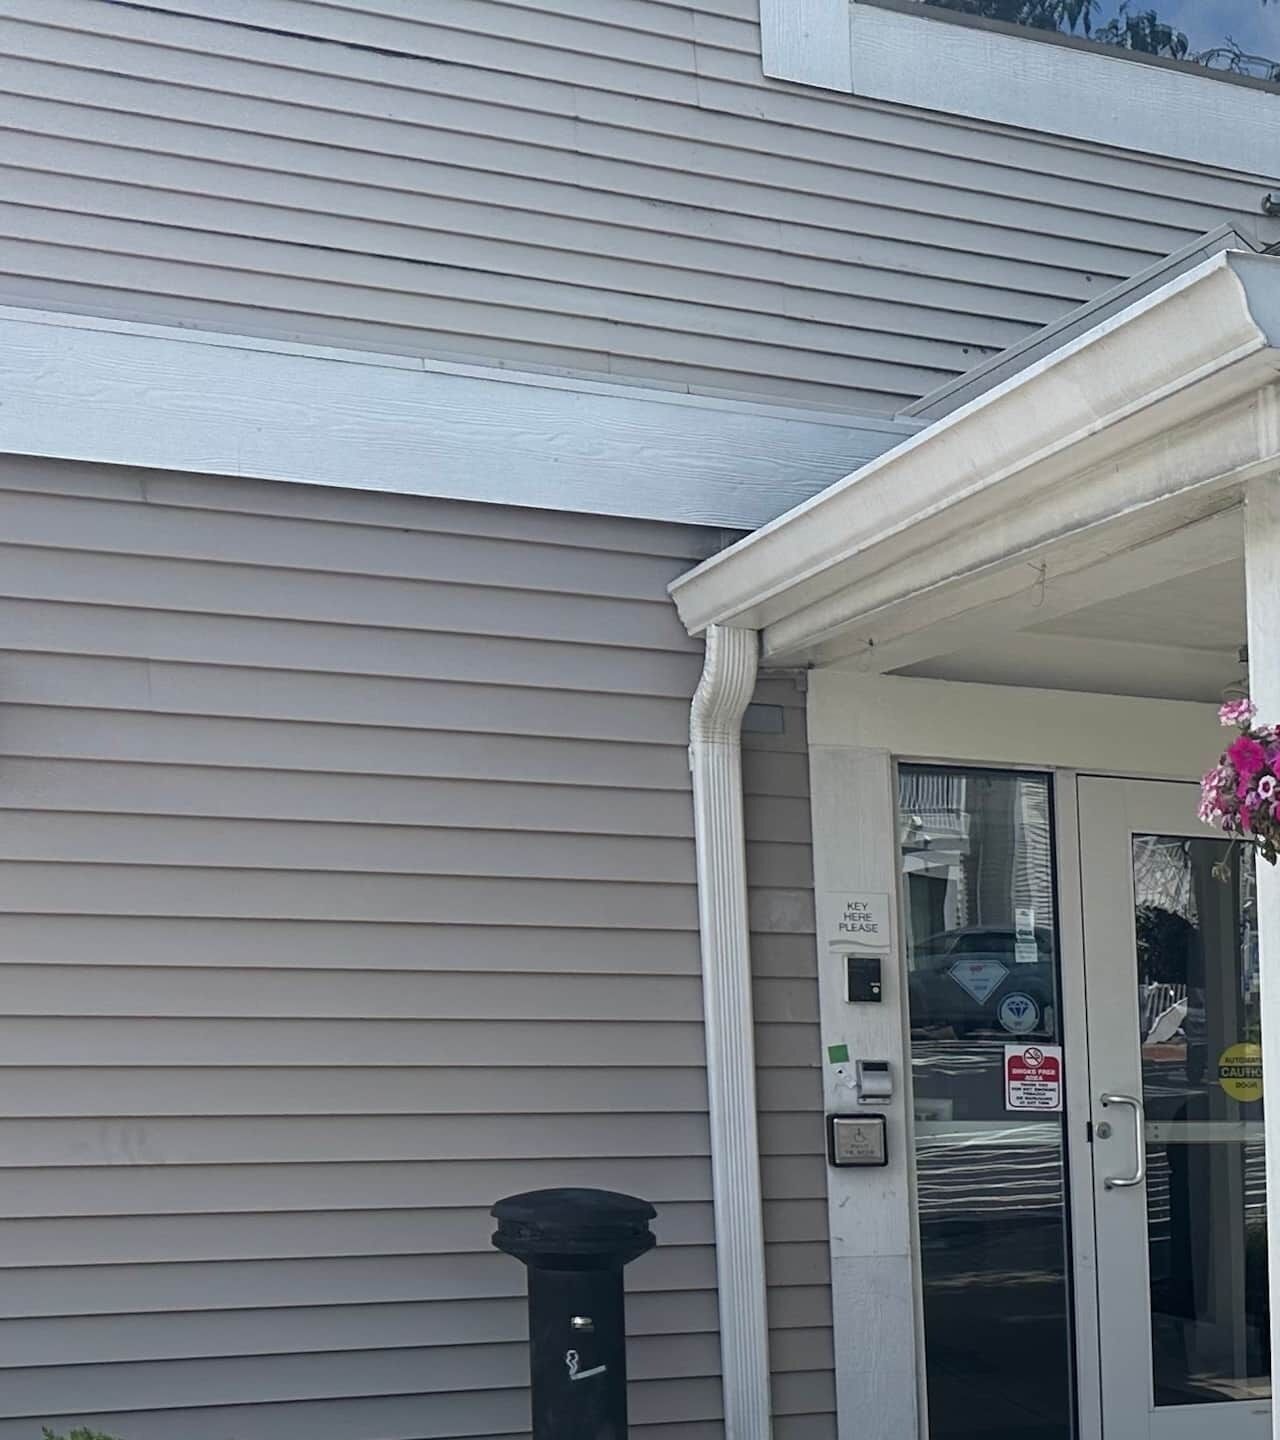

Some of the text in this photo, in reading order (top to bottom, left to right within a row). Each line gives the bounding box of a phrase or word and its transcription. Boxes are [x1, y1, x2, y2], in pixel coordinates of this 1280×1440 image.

[847, 901, 869, 911] KEY
[843, 912, 873, 921] HERE
[839, 922, 879, 933] PLEASE
[1221, 1067, 1263, 1077] CAUTIO
